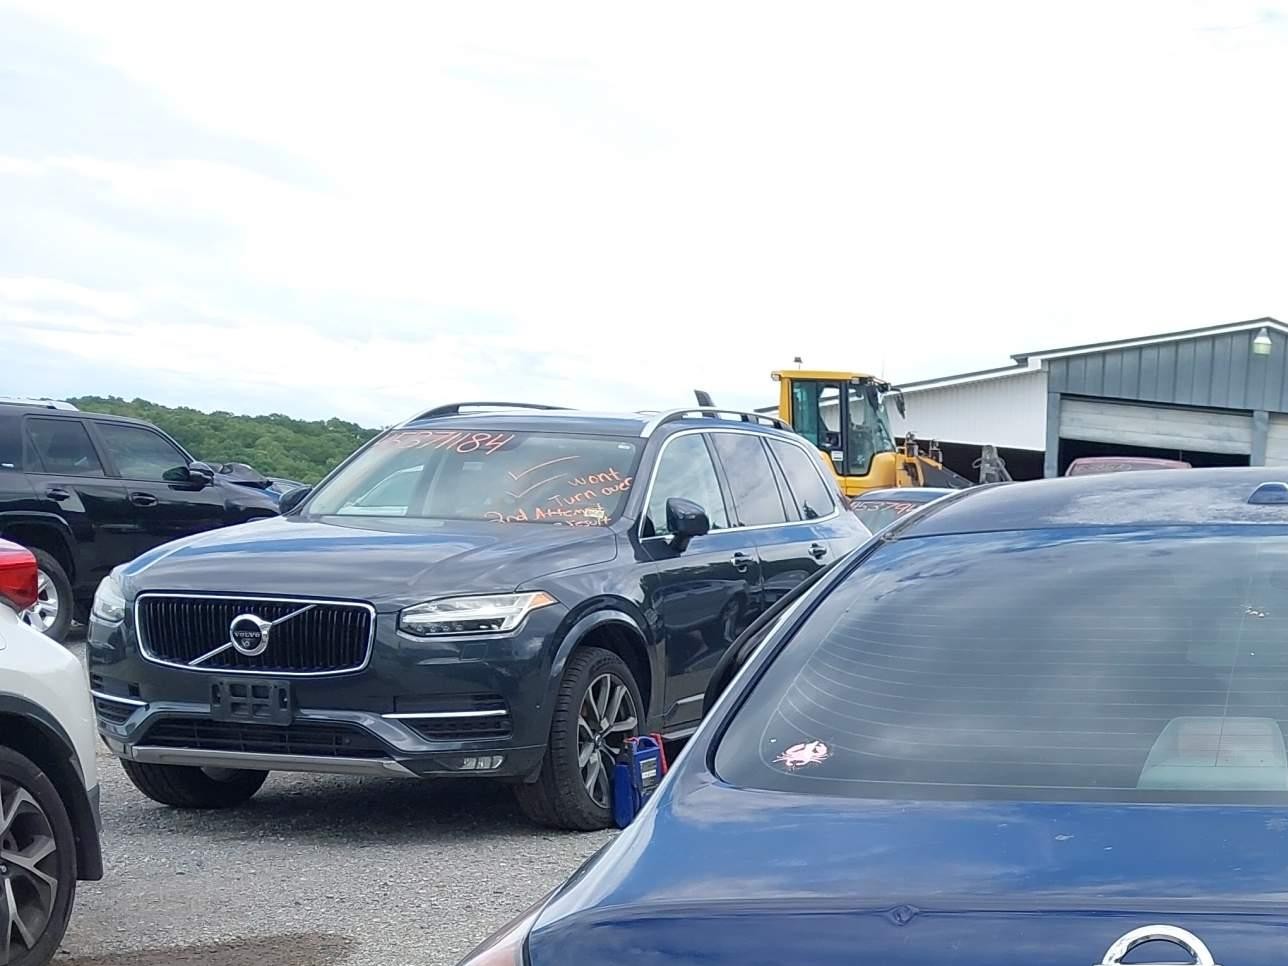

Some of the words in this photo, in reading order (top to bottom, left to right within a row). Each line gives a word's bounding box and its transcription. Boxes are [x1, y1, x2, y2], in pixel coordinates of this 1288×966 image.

[567, 466, 621, 487] wont
[547, 489, 597, 507] Turn
[484, 508, 529, 524] 2nd
[233, 630, 261, 638] VOLVO
